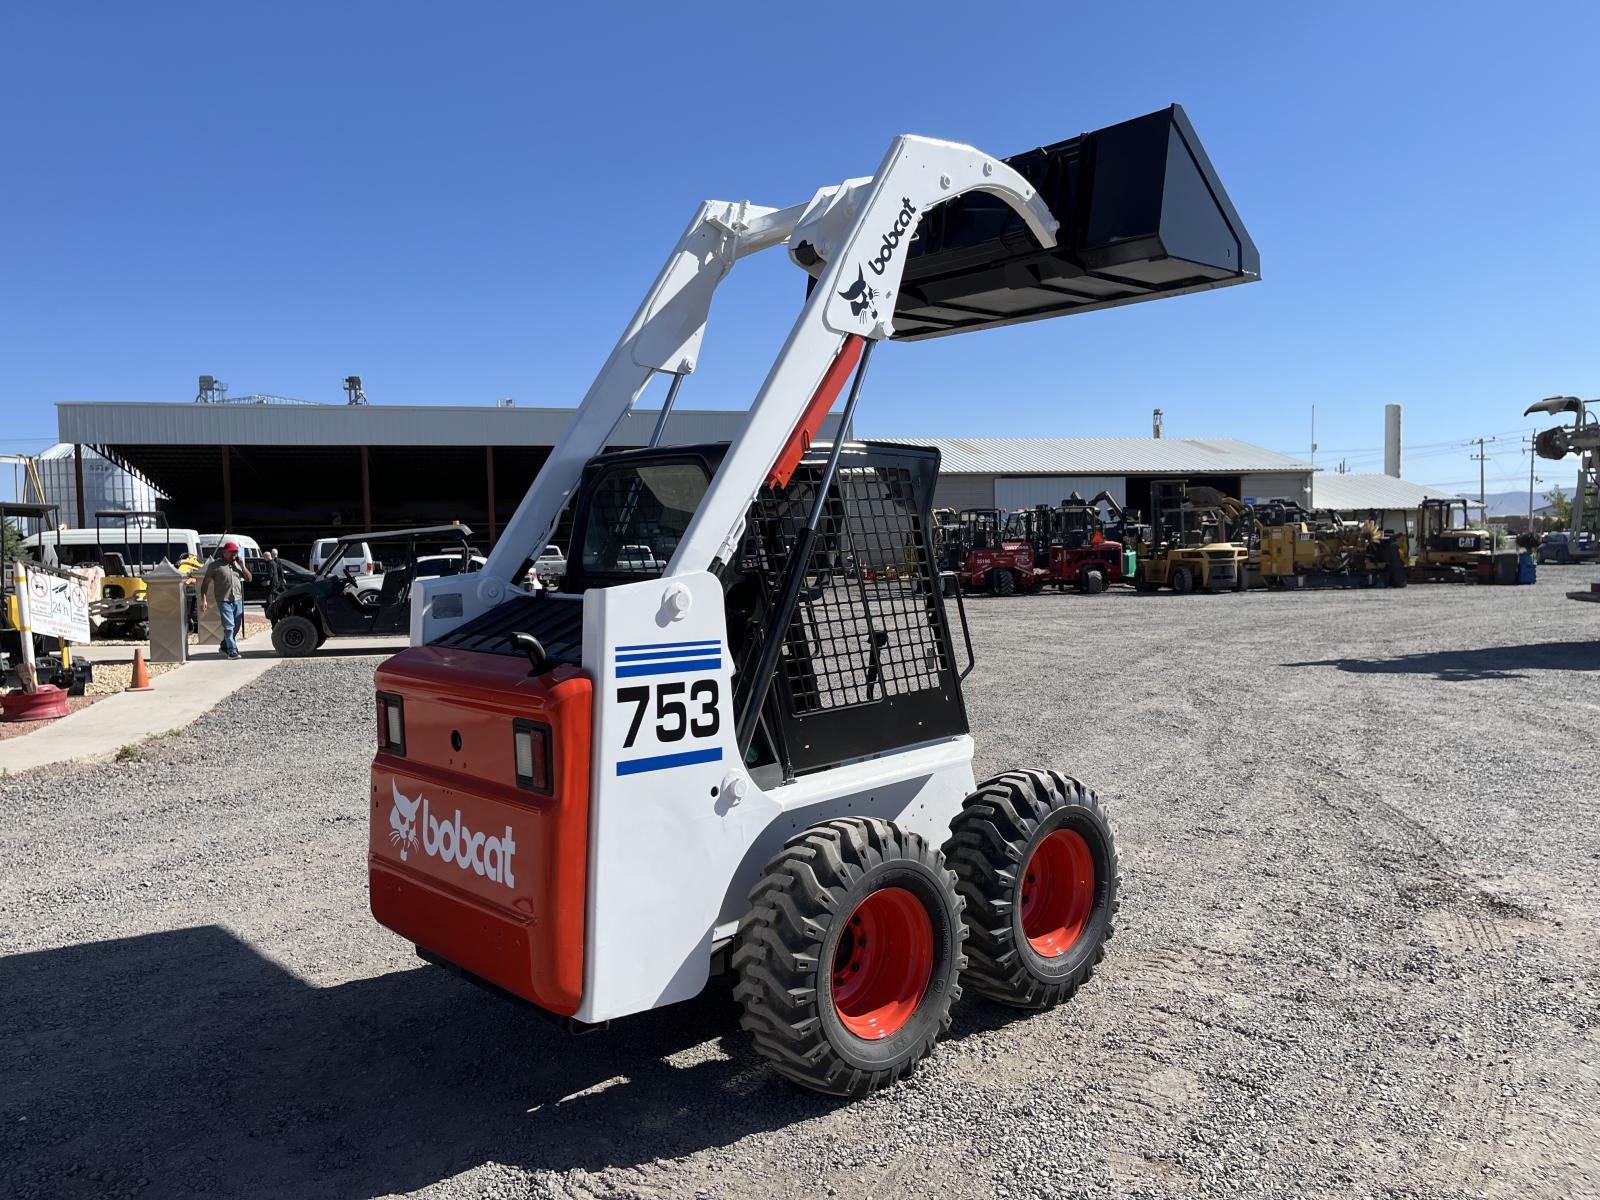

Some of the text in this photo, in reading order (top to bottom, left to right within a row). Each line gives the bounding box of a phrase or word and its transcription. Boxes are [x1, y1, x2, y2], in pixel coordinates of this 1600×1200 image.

[868, 197, 916, 275] bobcat
[1458, 536, 1475, 548] CAT
[52, 601, 61, 614] 24
[616, 679, 720, 748] 753
[422, 799, 515, 889] bobcat
